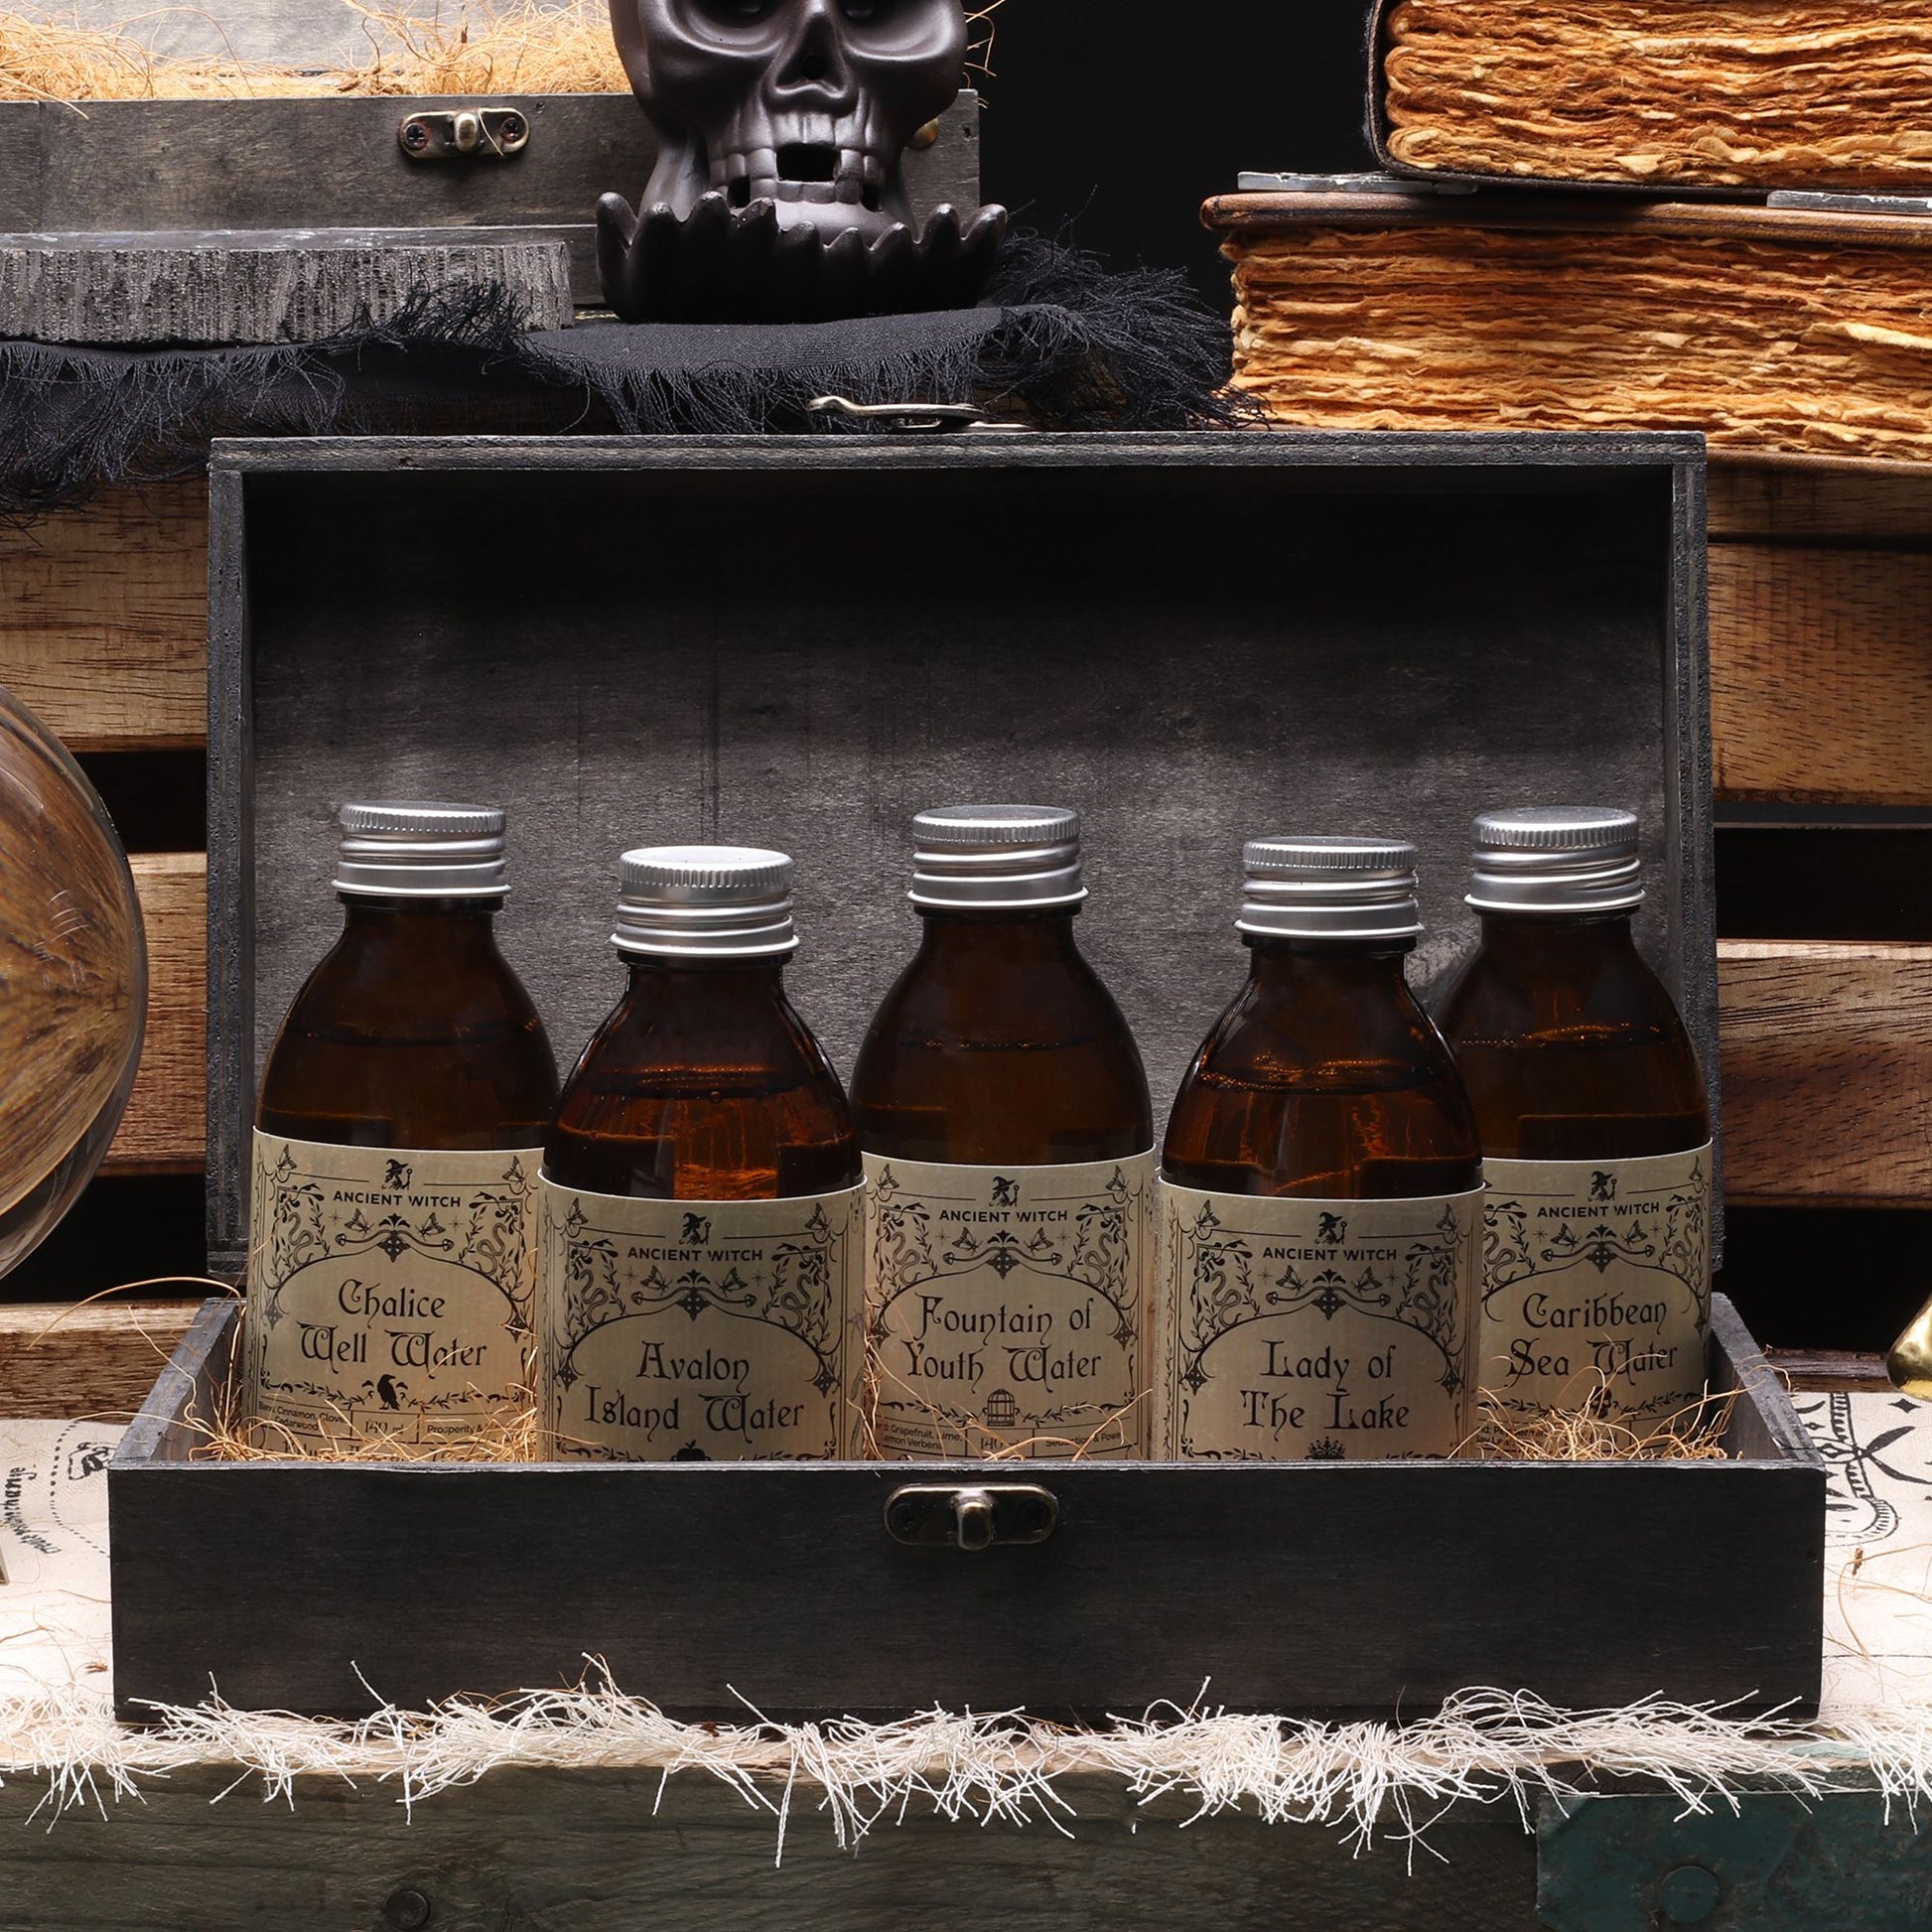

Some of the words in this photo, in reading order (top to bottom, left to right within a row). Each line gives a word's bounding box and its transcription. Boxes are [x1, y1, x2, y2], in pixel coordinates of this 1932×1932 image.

[333, 1190, 403, 1206] ANCIENT
[408, 1194, 462, 1208] WITCH
[939, 1209, 1010, 1223] ANCIENT
[1016, 1209, 1068, 1223] WITCH
[1537, 1204, 1609, 1218] ANCIENT
[1614, 1201, 1660, 1216] WITCH
[627, 1246, 701, 1262] ANCIENT
[707, 1249, 763, 1263] WITCH
[1262, 1247, 1338, 1262] ANCIENT
[1343, 1248, 1398, 1261] WITCH
[338, 1278, 446, 1329] Chalice
[913, 1291, 1053, 1346] Fountain
[1069, 1297, 1094, 1331] of
[1522, 1291, 1668, 1335] Caribbean
[297, 1320, 367, 1375] Well
[384, 1328, 487, 1380] Water
[635, 1340, 750, 1394] Avalon
[899, 1338, 985, 1395] Youth
[1001, 1344, 1102, 1393] Water
[1260, 1339, 1349, 1392] Lady
[1367, 1345, 1397, 1380] of
[1503, 1337, 1570, 1389] Sea
[1586, 1339, 1679, 1386] Water
[364, 1420, 388, 1434] 140
[584, 1383, 680, 1443] Island
[698, 1391, 805, 1444] Water
[1239, 1389, 1306, 1443] The
[1323, 1392, 1410, 1431] Lake
[884, 1434, 906, 1446] emon
